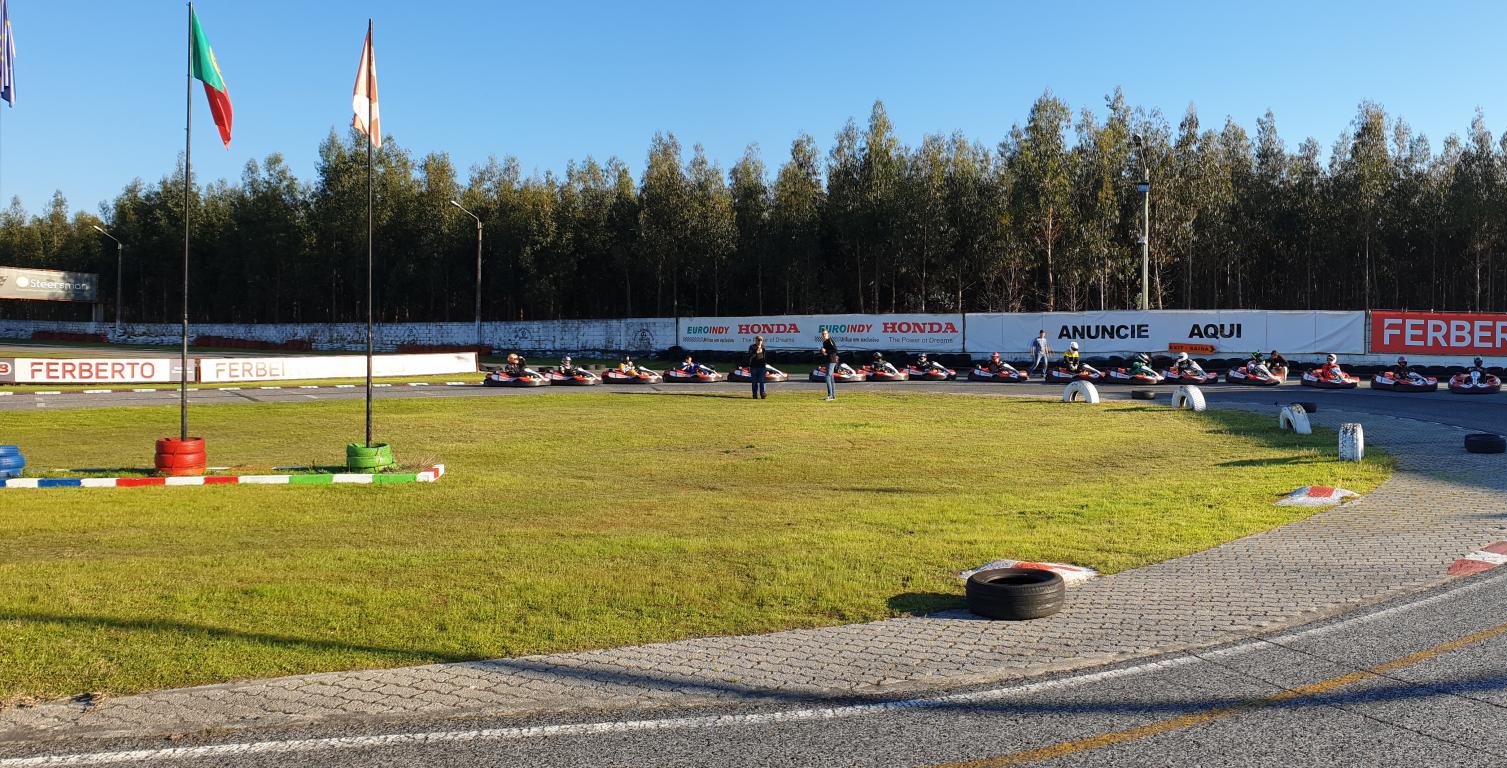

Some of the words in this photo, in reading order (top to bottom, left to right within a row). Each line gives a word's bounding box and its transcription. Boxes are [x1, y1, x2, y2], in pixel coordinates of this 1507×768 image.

[687, 326, 730, 335] EUROINDY
[738, 323, 800, 335] HONDA
[882, 321, 959, 334] HONDA
[1058, 324, 1149, 339] ANUNCIE
[1188, 323, 1242, 339] AQUI
[30, 361, 155, 380] FERBERTO
